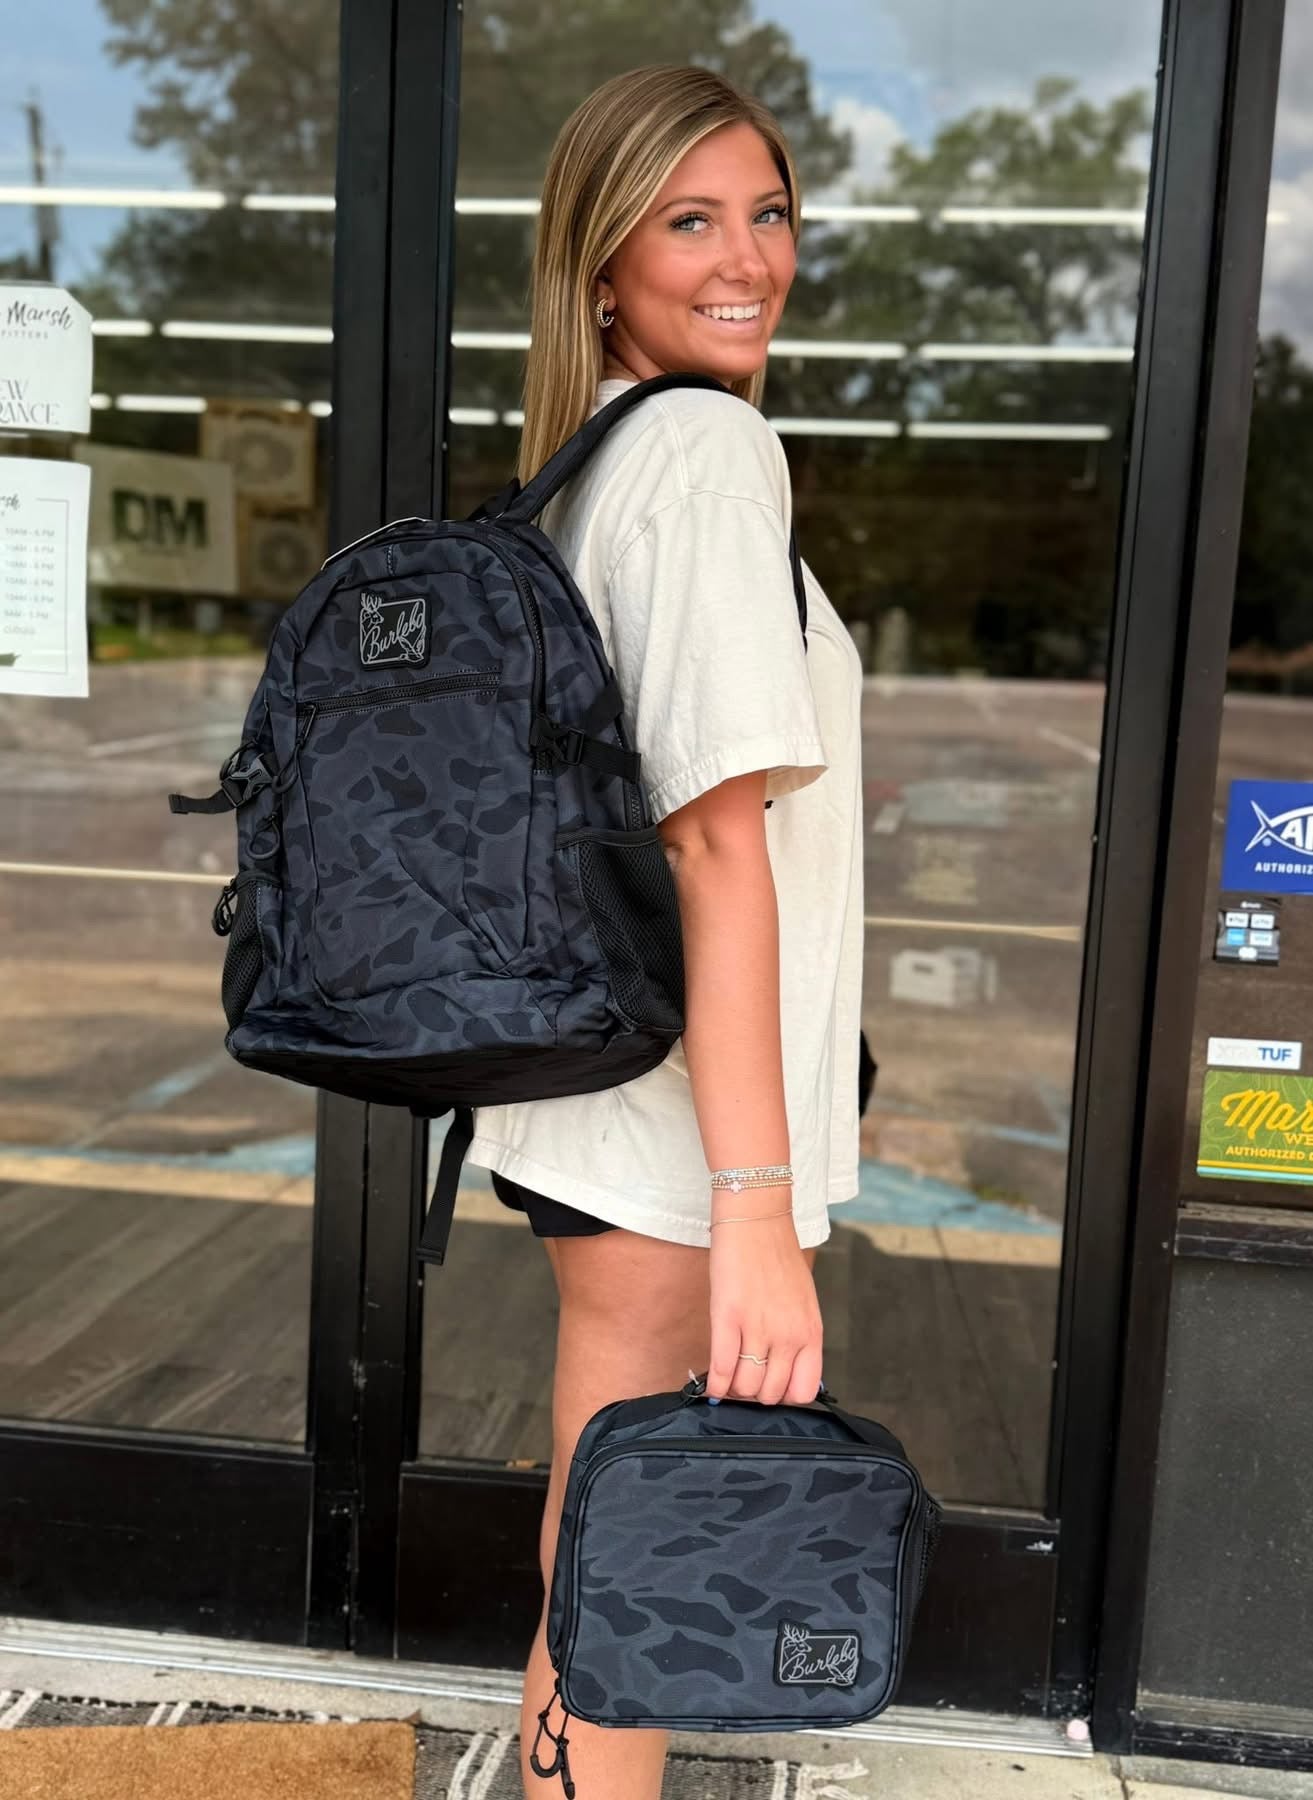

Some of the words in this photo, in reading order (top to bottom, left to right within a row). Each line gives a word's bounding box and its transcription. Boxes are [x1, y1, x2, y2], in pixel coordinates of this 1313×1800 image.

[7, 300, 74, 330] Marsh
[112, 488, 207, 549] DM
[1225, 1146, 1305, 1160] AUTHORIZED
